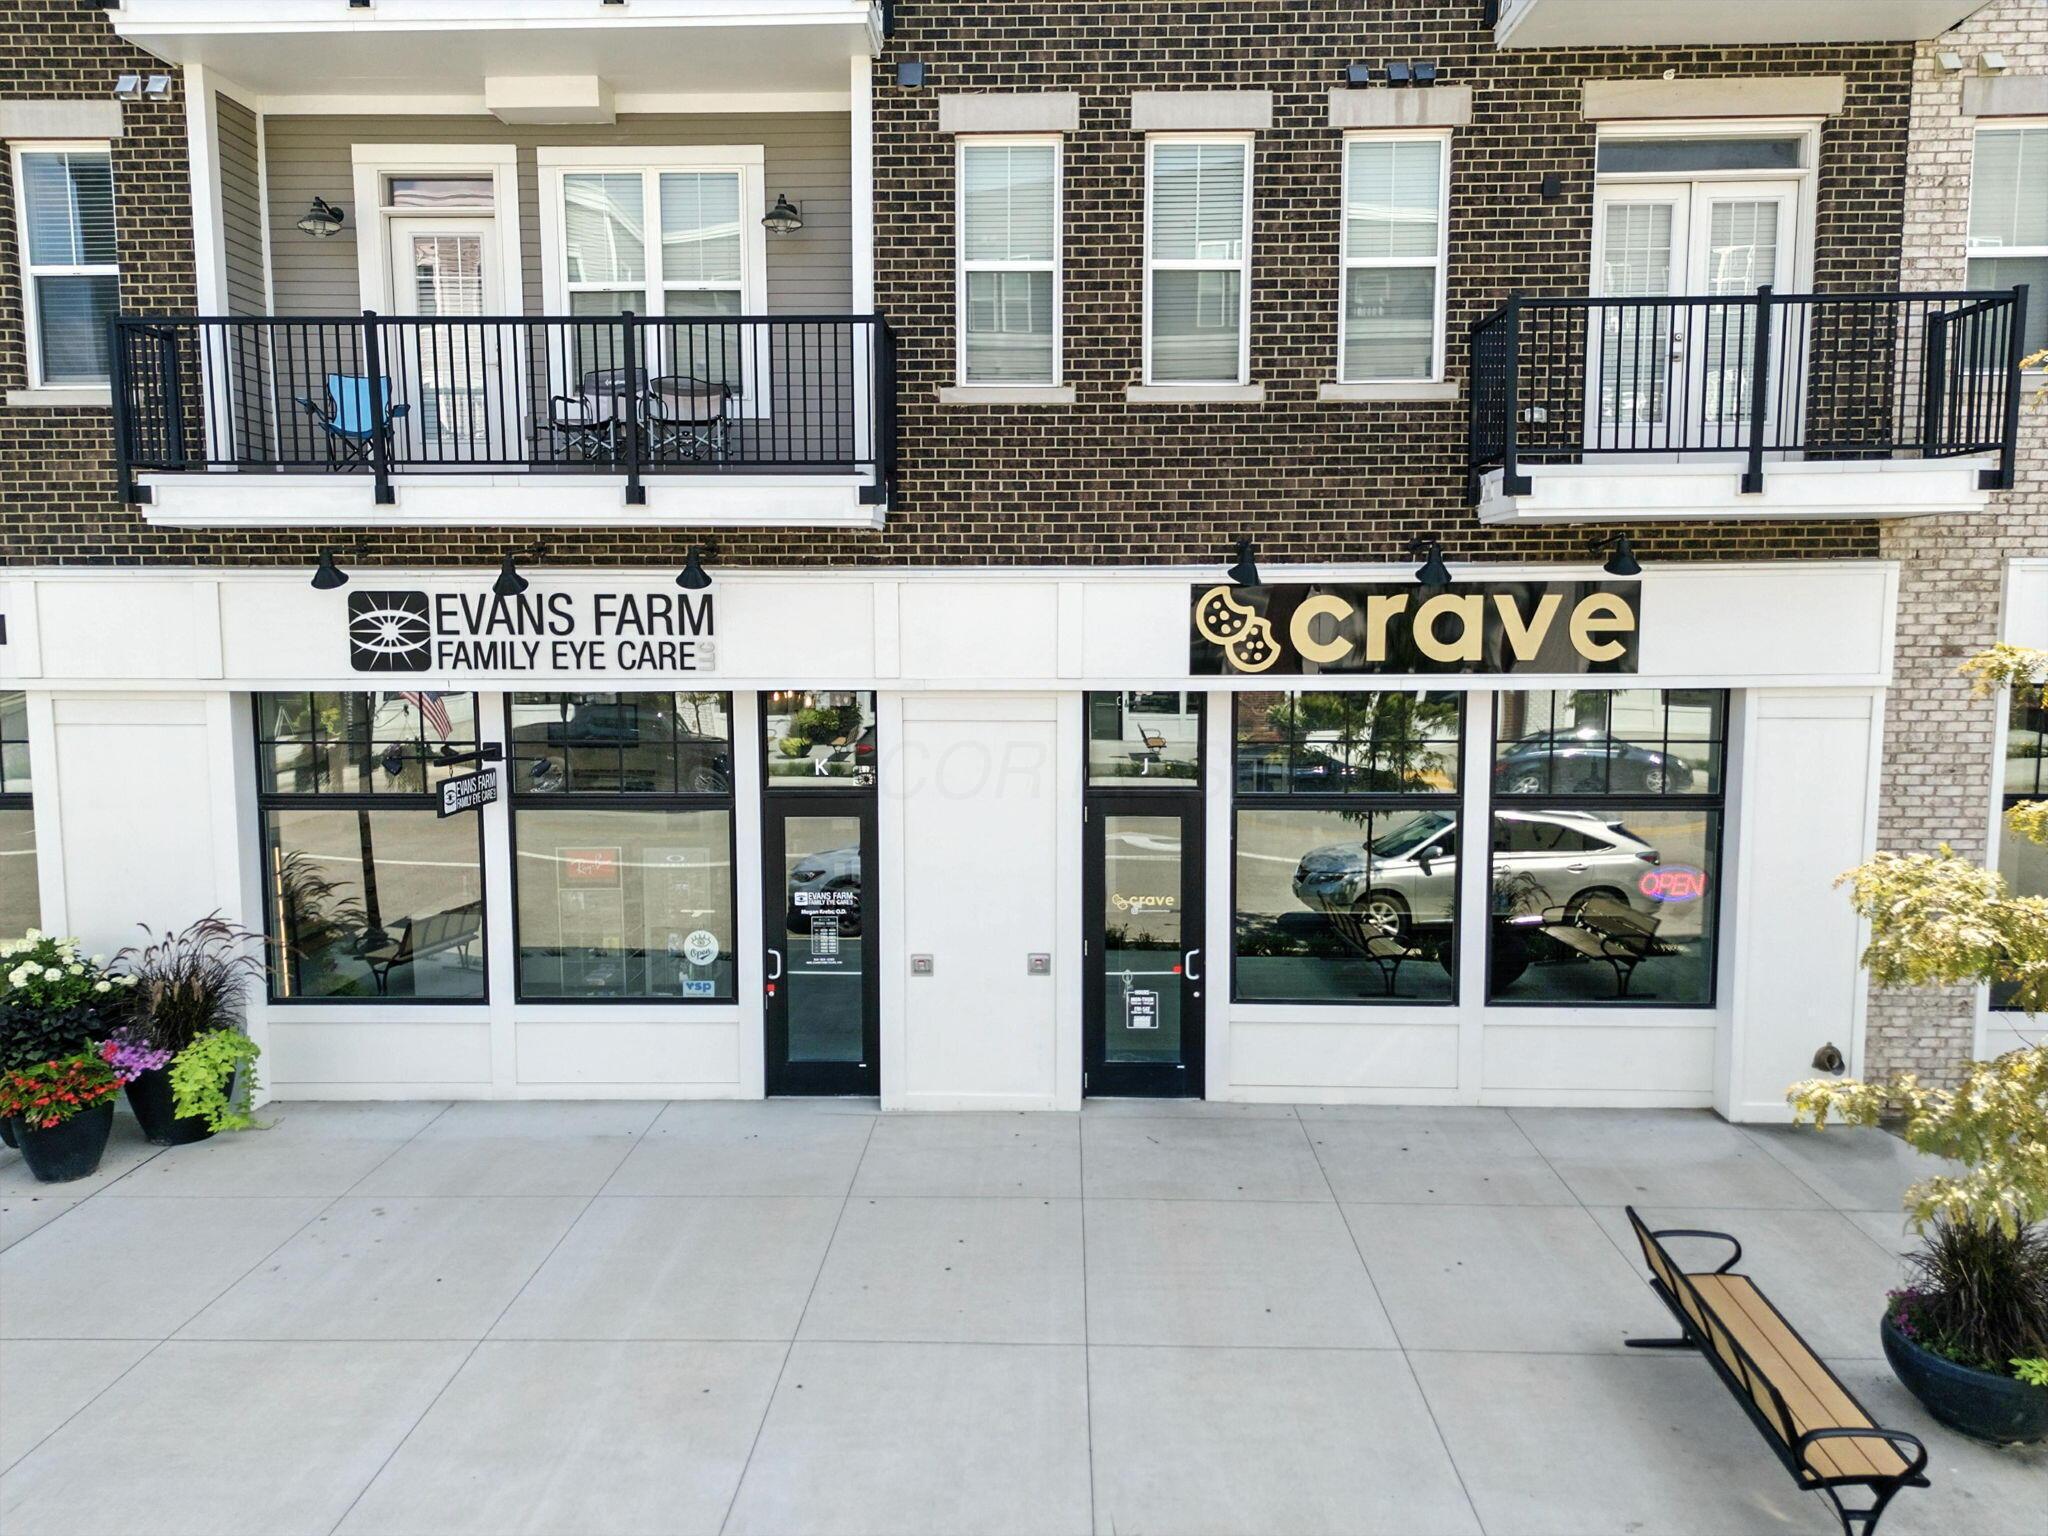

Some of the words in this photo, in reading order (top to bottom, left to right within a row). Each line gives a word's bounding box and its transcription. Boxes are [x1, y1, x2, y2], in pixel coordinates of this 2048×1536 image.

[436, 593, 575, 636] EVANS
[594, 593, 714, 636] FARM
[1290, 593, 1636, 663] crave
[437, 641, 540, 670] FAMILY
[551, 641, 606, 670] EYE
[617, 641, 697, 670] CARE
[815, 758, 829, 776] K
[1141, 758, 1149, 775] J
[456, 777, 476, 797] EVANS
[477, 772, 495, 790] FARM
[456, 793, 472, 809] FAMILY
[472, 792, 481, 804] EYE
[481, 788, 494, 800] CARE
[1638, 871, 1706, 897] OPEN
[1129, 895, 1175, 906] crave
[686, 982, 712, 992] vsp
